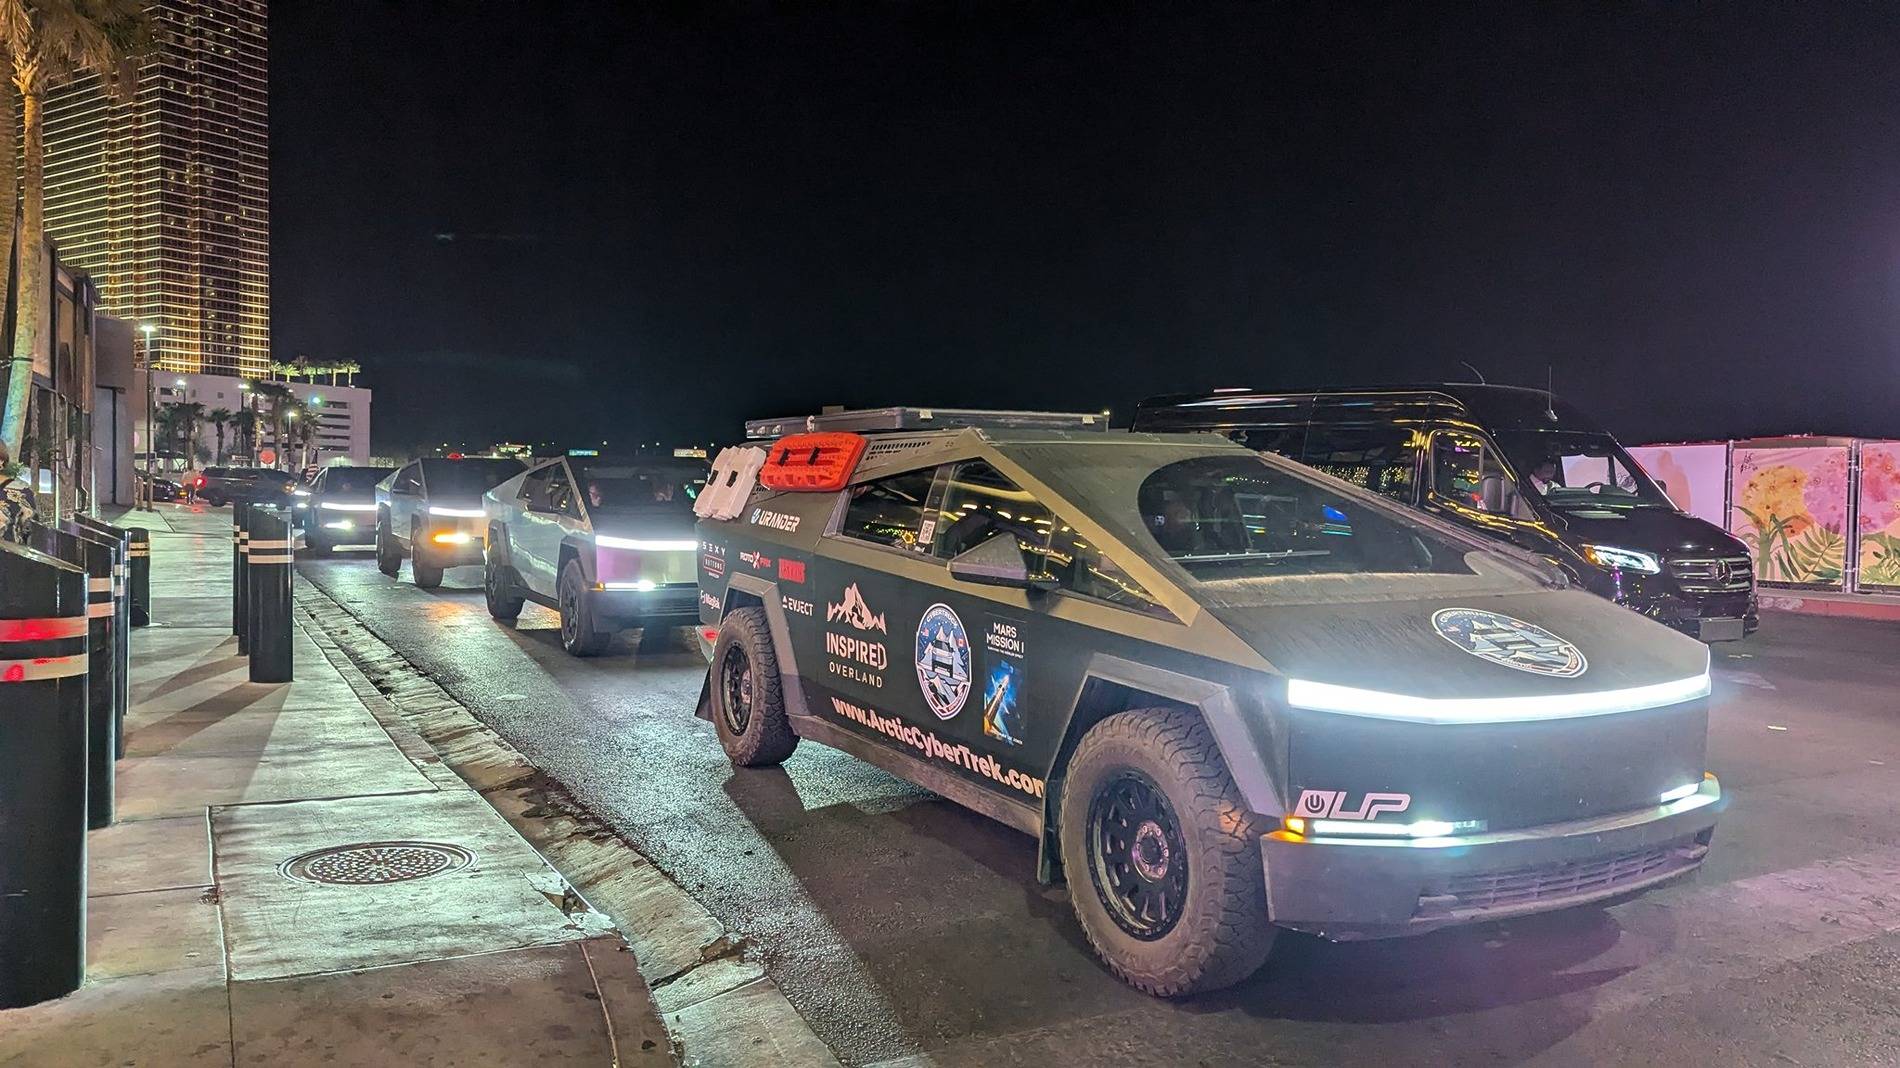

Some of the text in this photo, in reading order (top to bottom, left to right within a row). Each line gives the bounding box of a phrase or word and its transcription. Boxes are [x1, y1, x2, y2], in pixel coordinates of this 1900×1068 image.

[788, 597, 814, 617] EVJECT
[993, 622, 1017, 638] MARS
[826, 632, 888, 671] INSPIRED
[986, 633, 1019, 652] MISSION
[829, 661, 883, 689] OVERLAND
